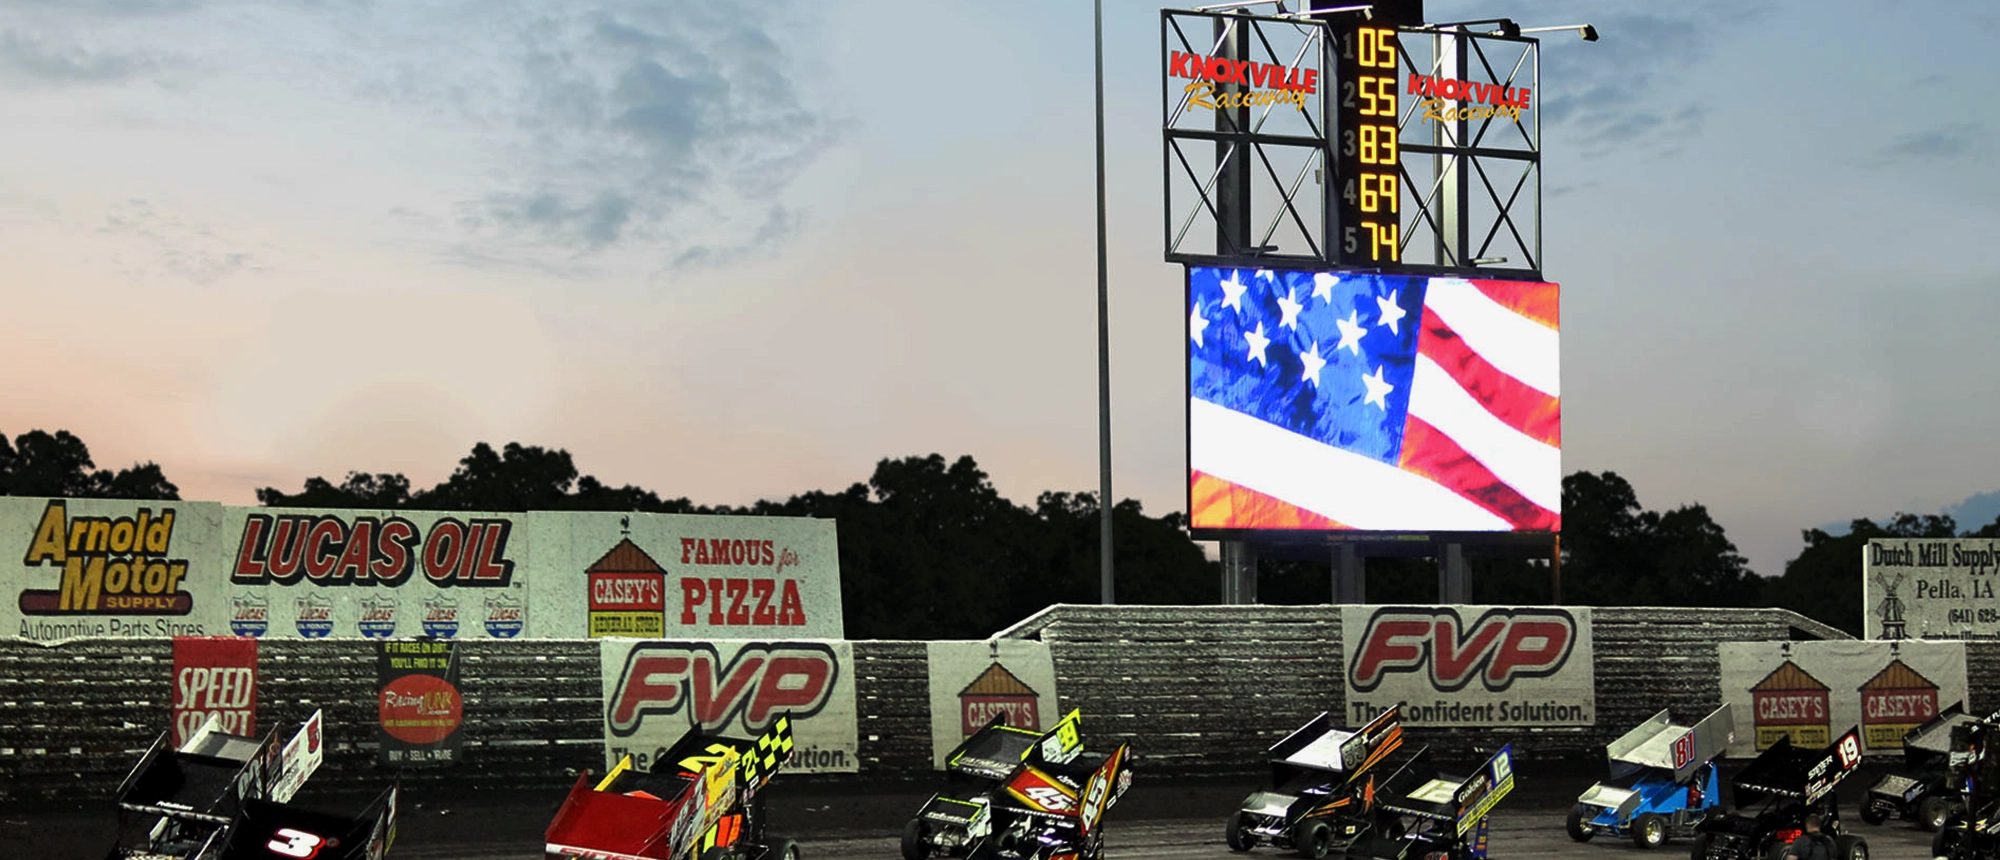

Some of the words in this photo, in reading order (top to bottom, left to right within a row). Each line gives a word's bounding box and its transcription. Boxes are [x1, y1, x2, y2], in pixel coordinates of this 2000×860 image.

[1343, 33, 1354, 59] 1
[1358, 28, 1396, 68] 05
[1169, 50, 1318, 94] KNOXVILLE
[1184, 82, 1307, 112] Raceway
[1343, 81, 1356, 108] 2
[1359, 76, 1396, 117] 55
[1407, 73, 1531, 109] KNOXVILLE
[1420, 99, 1521, 124] Raceway
[1343, 130, 1356, 156] 3
[1360, 125, 1397, 165] 83
[1343, 178, 1357, 205] 4
[1360, 173, 1397, 213] 69
[1344, 227, 1357, 253] 5
[1361, 222, 1398, 262] 74
[24, 499, 176, 566] Arnold
[230, 514, 421, 588] LUCAS
[422, 517, 515, 588] OIL
[680, 537, 775, 566] FAMOUS
[777, 549, 800, 575] for
[1872, 542, 1914, 567] Dutch
[1918, 542, 1948, 567] Mill
[1952, 542, 2000, 576] Supply
[58, 554, 189, 613] Motor
[594, 579, 658, 604] CASEY'S
[1917, 579, 1966, 600] Pella,
[1973, 579, 1995, 599] IA
[106, 596, 177, 609] SUPPLY
[235, 608, 267, 620] LUCAS
[300, 608, 330, 620] LUCAS
[362, 609, 394, 621] LUCAS
[426, 609, 457, 621] LUCAS
[488, 609, 520, 621] LUCAS
[680, 577, 806, 626] PIZZA
[1948, 608, 1975, 626] (641)
[19, 619, 105, 641] Automotive
[109, 619, 150, 637] Parts
[155, 619, 204, 637] Stores
[1349, 606, 1577, 692] FVP
[175, 666, 253, 709] SPEED
[608, 641, 839, 738] FVP
[1399, 701, 1493, 722] Confident
[1500, 701, 1588, 722] Solution.
[1759, 696, 1823, 719] CASEY'S
[1866, 694, 1933, 717] CASEY'S
[1675, 730, 1696, 770] 81
[1837, 733, 1861, 769] 19
[1492, 752, 1511, 784] 12
[266, 827, 327, 860] 3
